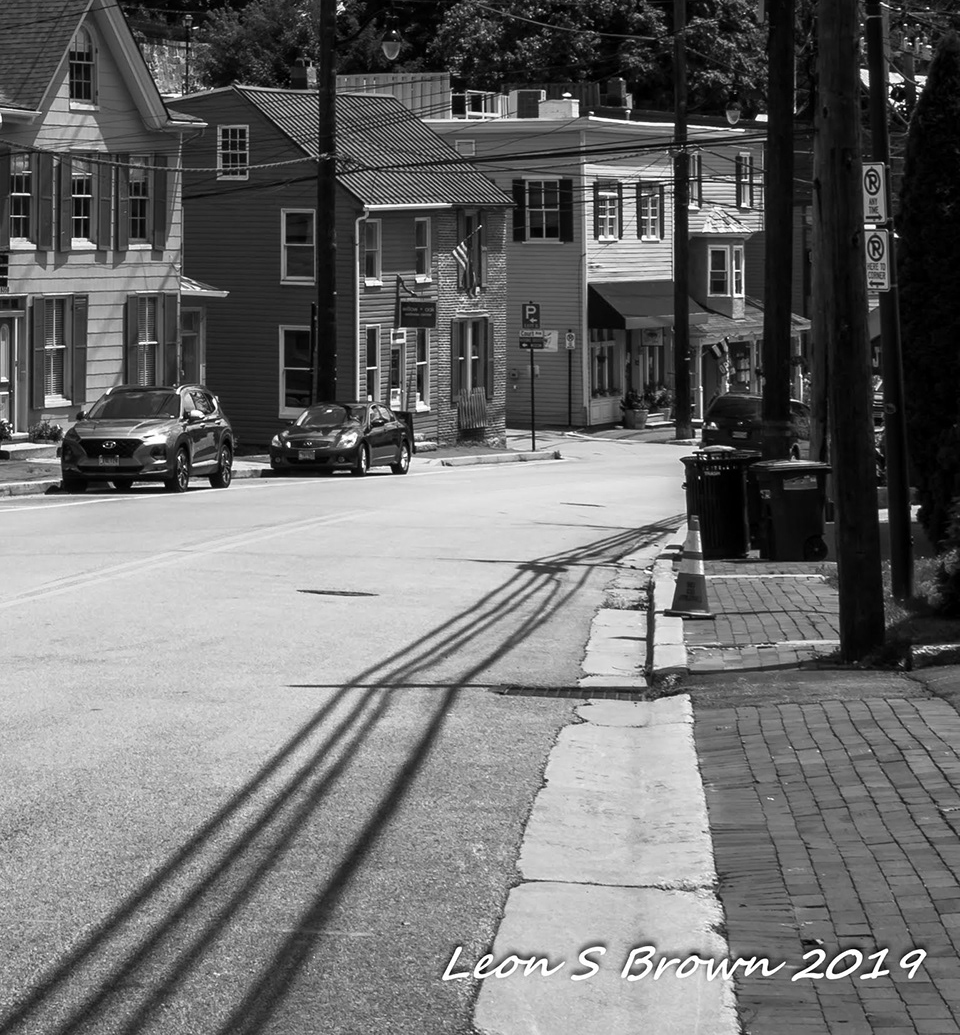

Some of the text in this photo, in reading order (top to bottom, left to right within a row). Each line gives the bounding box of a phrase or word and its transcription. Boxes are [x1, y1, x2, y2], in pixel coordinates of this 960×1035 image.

[869, 197, 878, 206] ANY
[869, 206, 879, 215] TIME
[867, 263, 886, 271] HERE TO
[868, 271, 886, 280] CORNER
